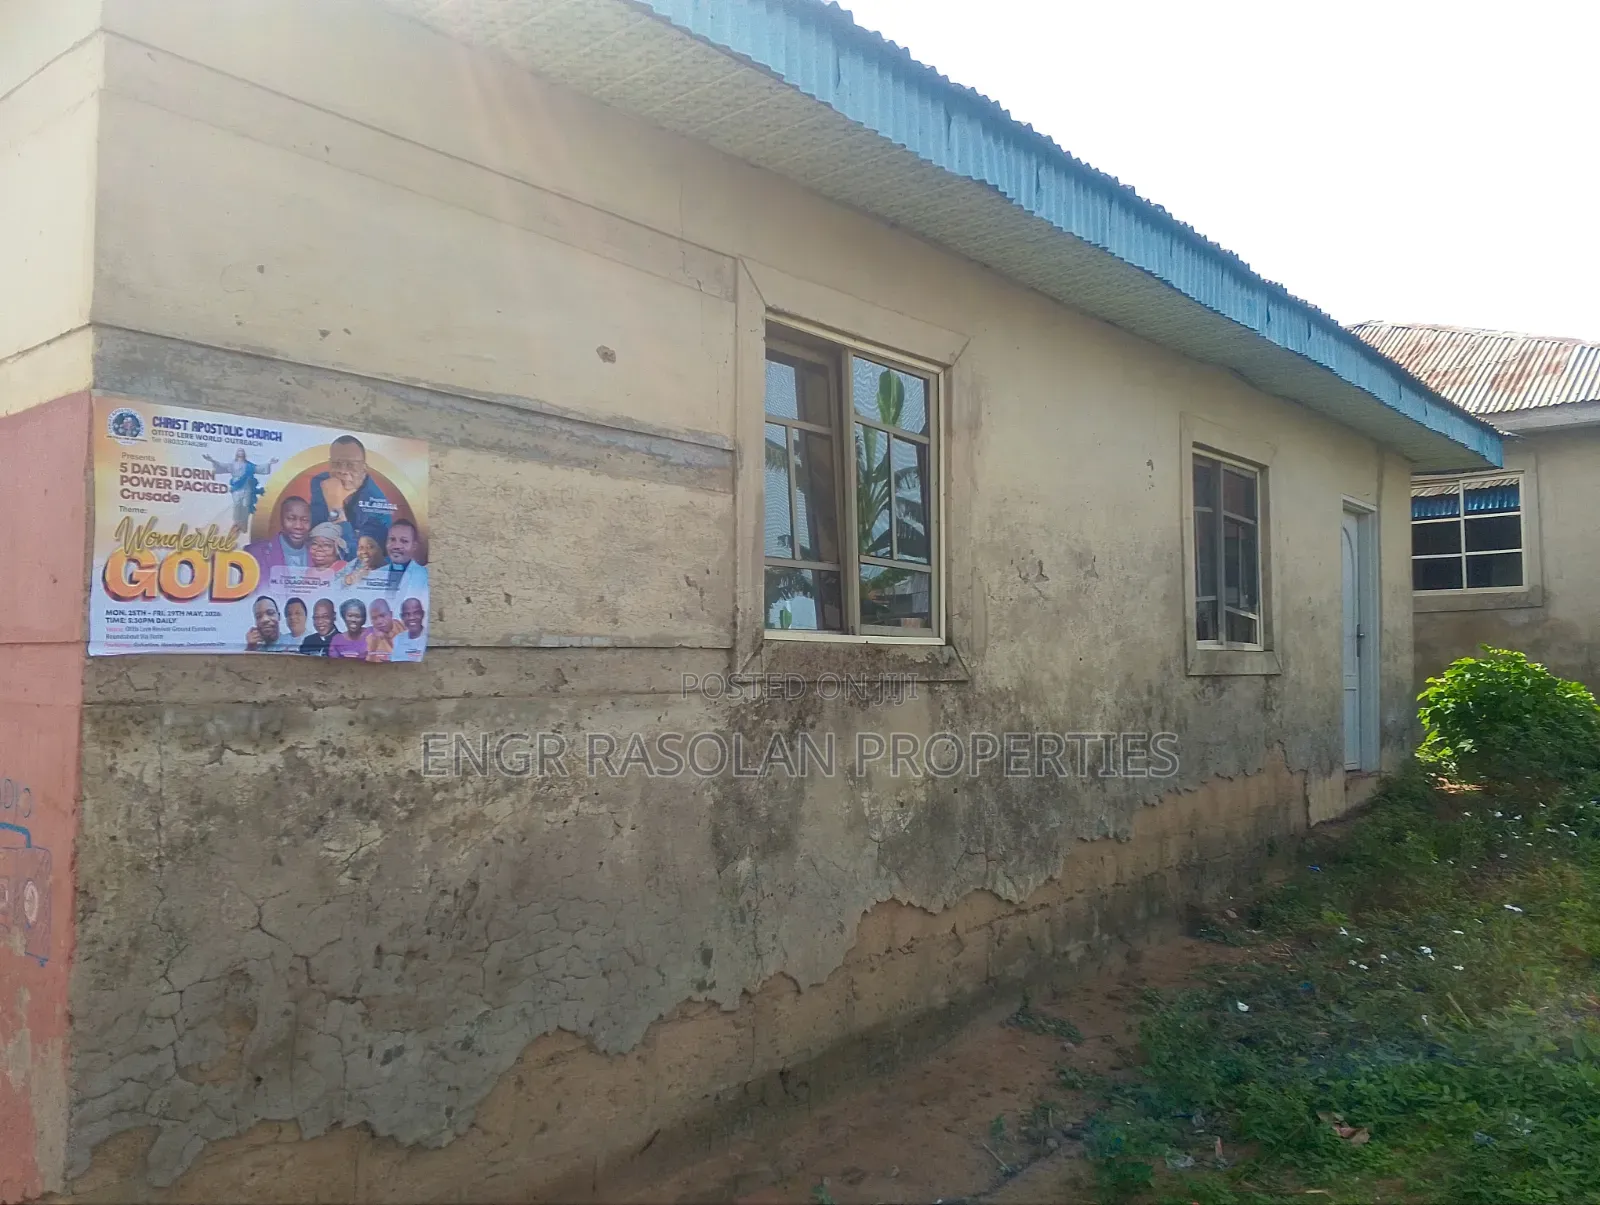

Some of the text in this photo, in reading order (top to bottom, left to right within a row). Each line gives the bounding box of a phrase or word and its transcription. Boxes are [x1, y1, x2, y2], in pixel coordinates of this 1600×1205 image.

[152, 415, 189, 431] CHRIST
[191, 420, 244, 437] APOSTOLIC
[245, 426, 283, 442] CHURCH
[194, 433, 222, 443] WORLD
[121, 451, 156, 462] Presents
[119, 463, 216, 481] 5 DAYS ILORIN
[120, 475, 228, 494] POWER PACKED
[120, 488, 180, 503] Crusade
[118, 505, 148, 514] Theme:
[114, 515, 239, 560] Wonderful
[102, 548, 260, 603] GOD
[128, 609, 147, 617] 25TH
